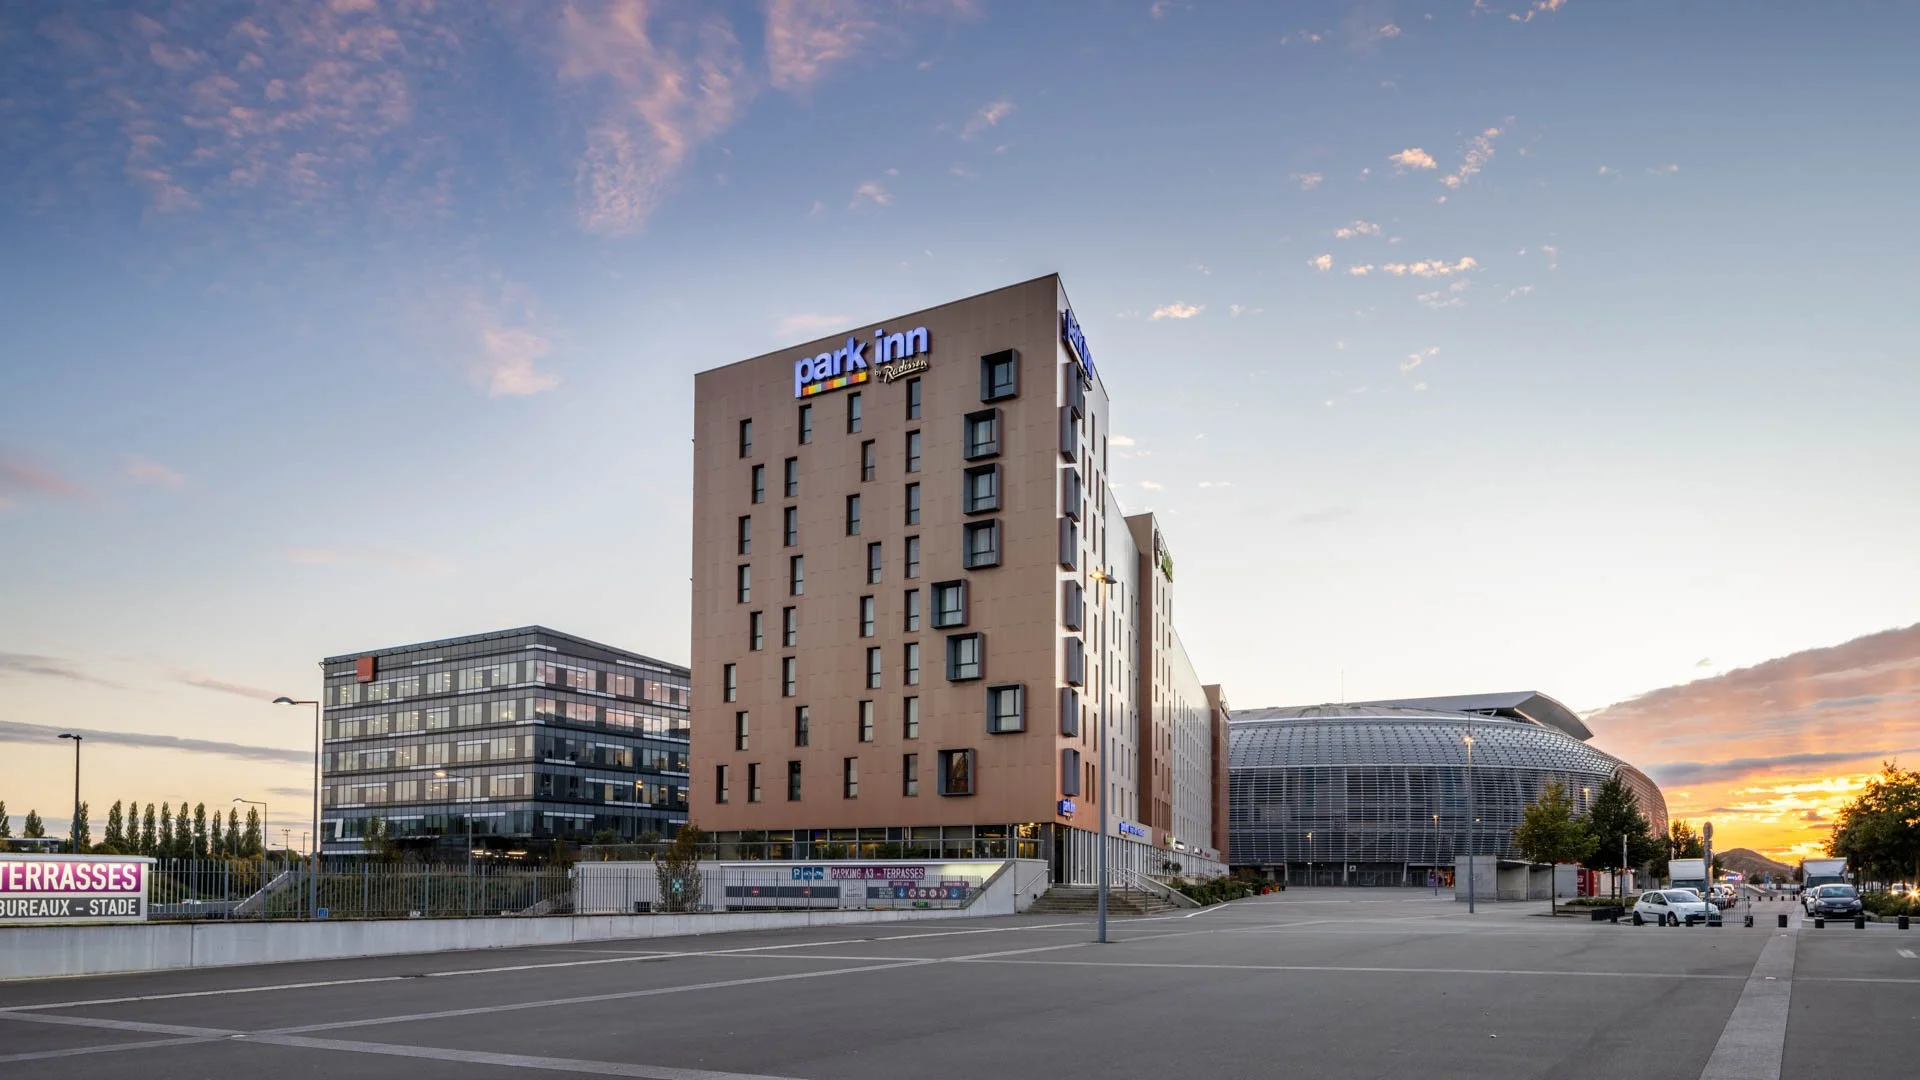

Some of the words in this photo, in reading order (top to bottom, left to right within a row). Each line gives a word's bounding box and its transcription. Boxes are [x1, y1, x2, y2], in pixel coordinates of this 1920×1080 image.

[795, 336, 868, 398] park
[874, 326, 928, 364] inn
[874, 369, 881, 377] by
[883, 358, 928, 384] Radisson
[0, 862, 137, 890] TERRASSES
[832, 868, 862, 879] PARKING
[865, 868, 874, 879] A3
[883, 867, 924, 879] TERRASSES
[0, 899, 70, 916] BUREAUX
[89, 899, 137, 915] STADE
